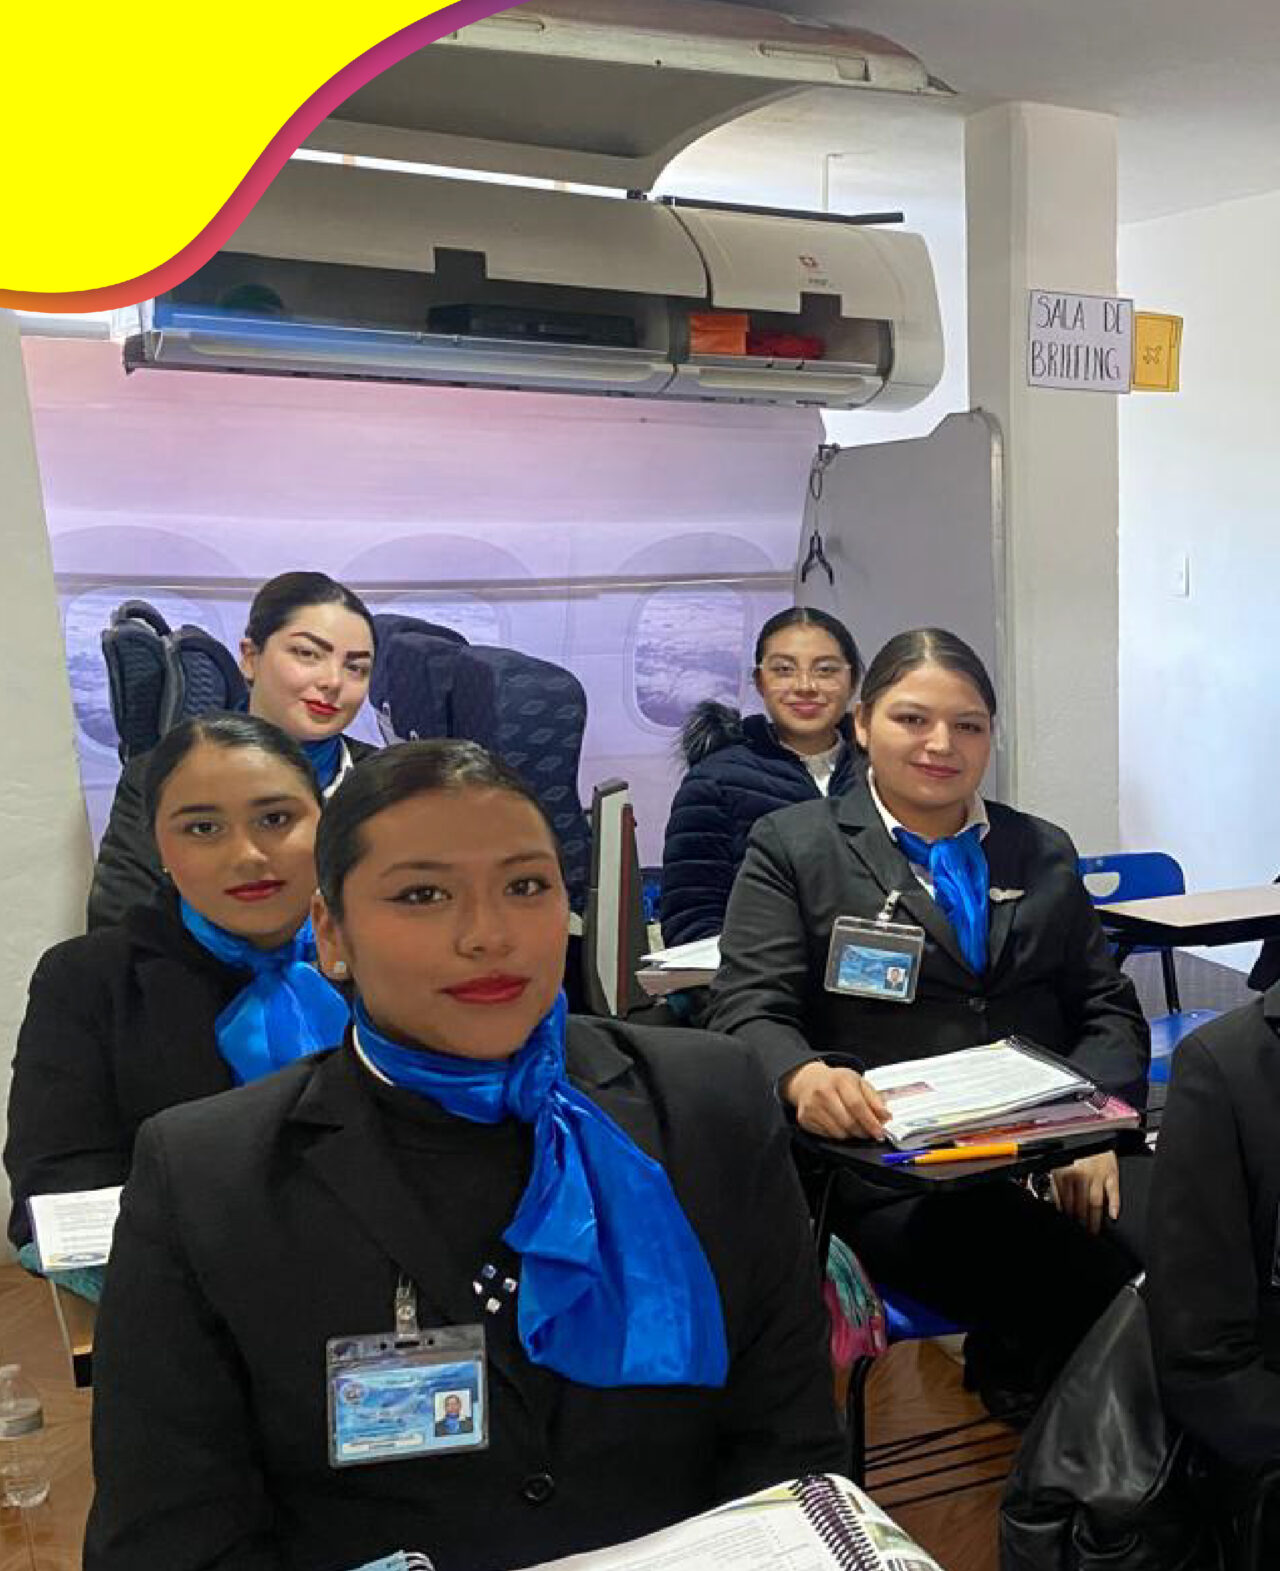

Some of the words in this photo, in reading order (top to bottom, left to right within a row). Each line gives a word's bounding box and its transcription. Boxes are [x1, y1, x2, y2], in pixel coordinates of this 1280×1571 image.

[1036, 295, 1085, 331] SALA
[1104, 301, 1126, 334] DE
[1031, 340, 1120, 381] BRIEFING
